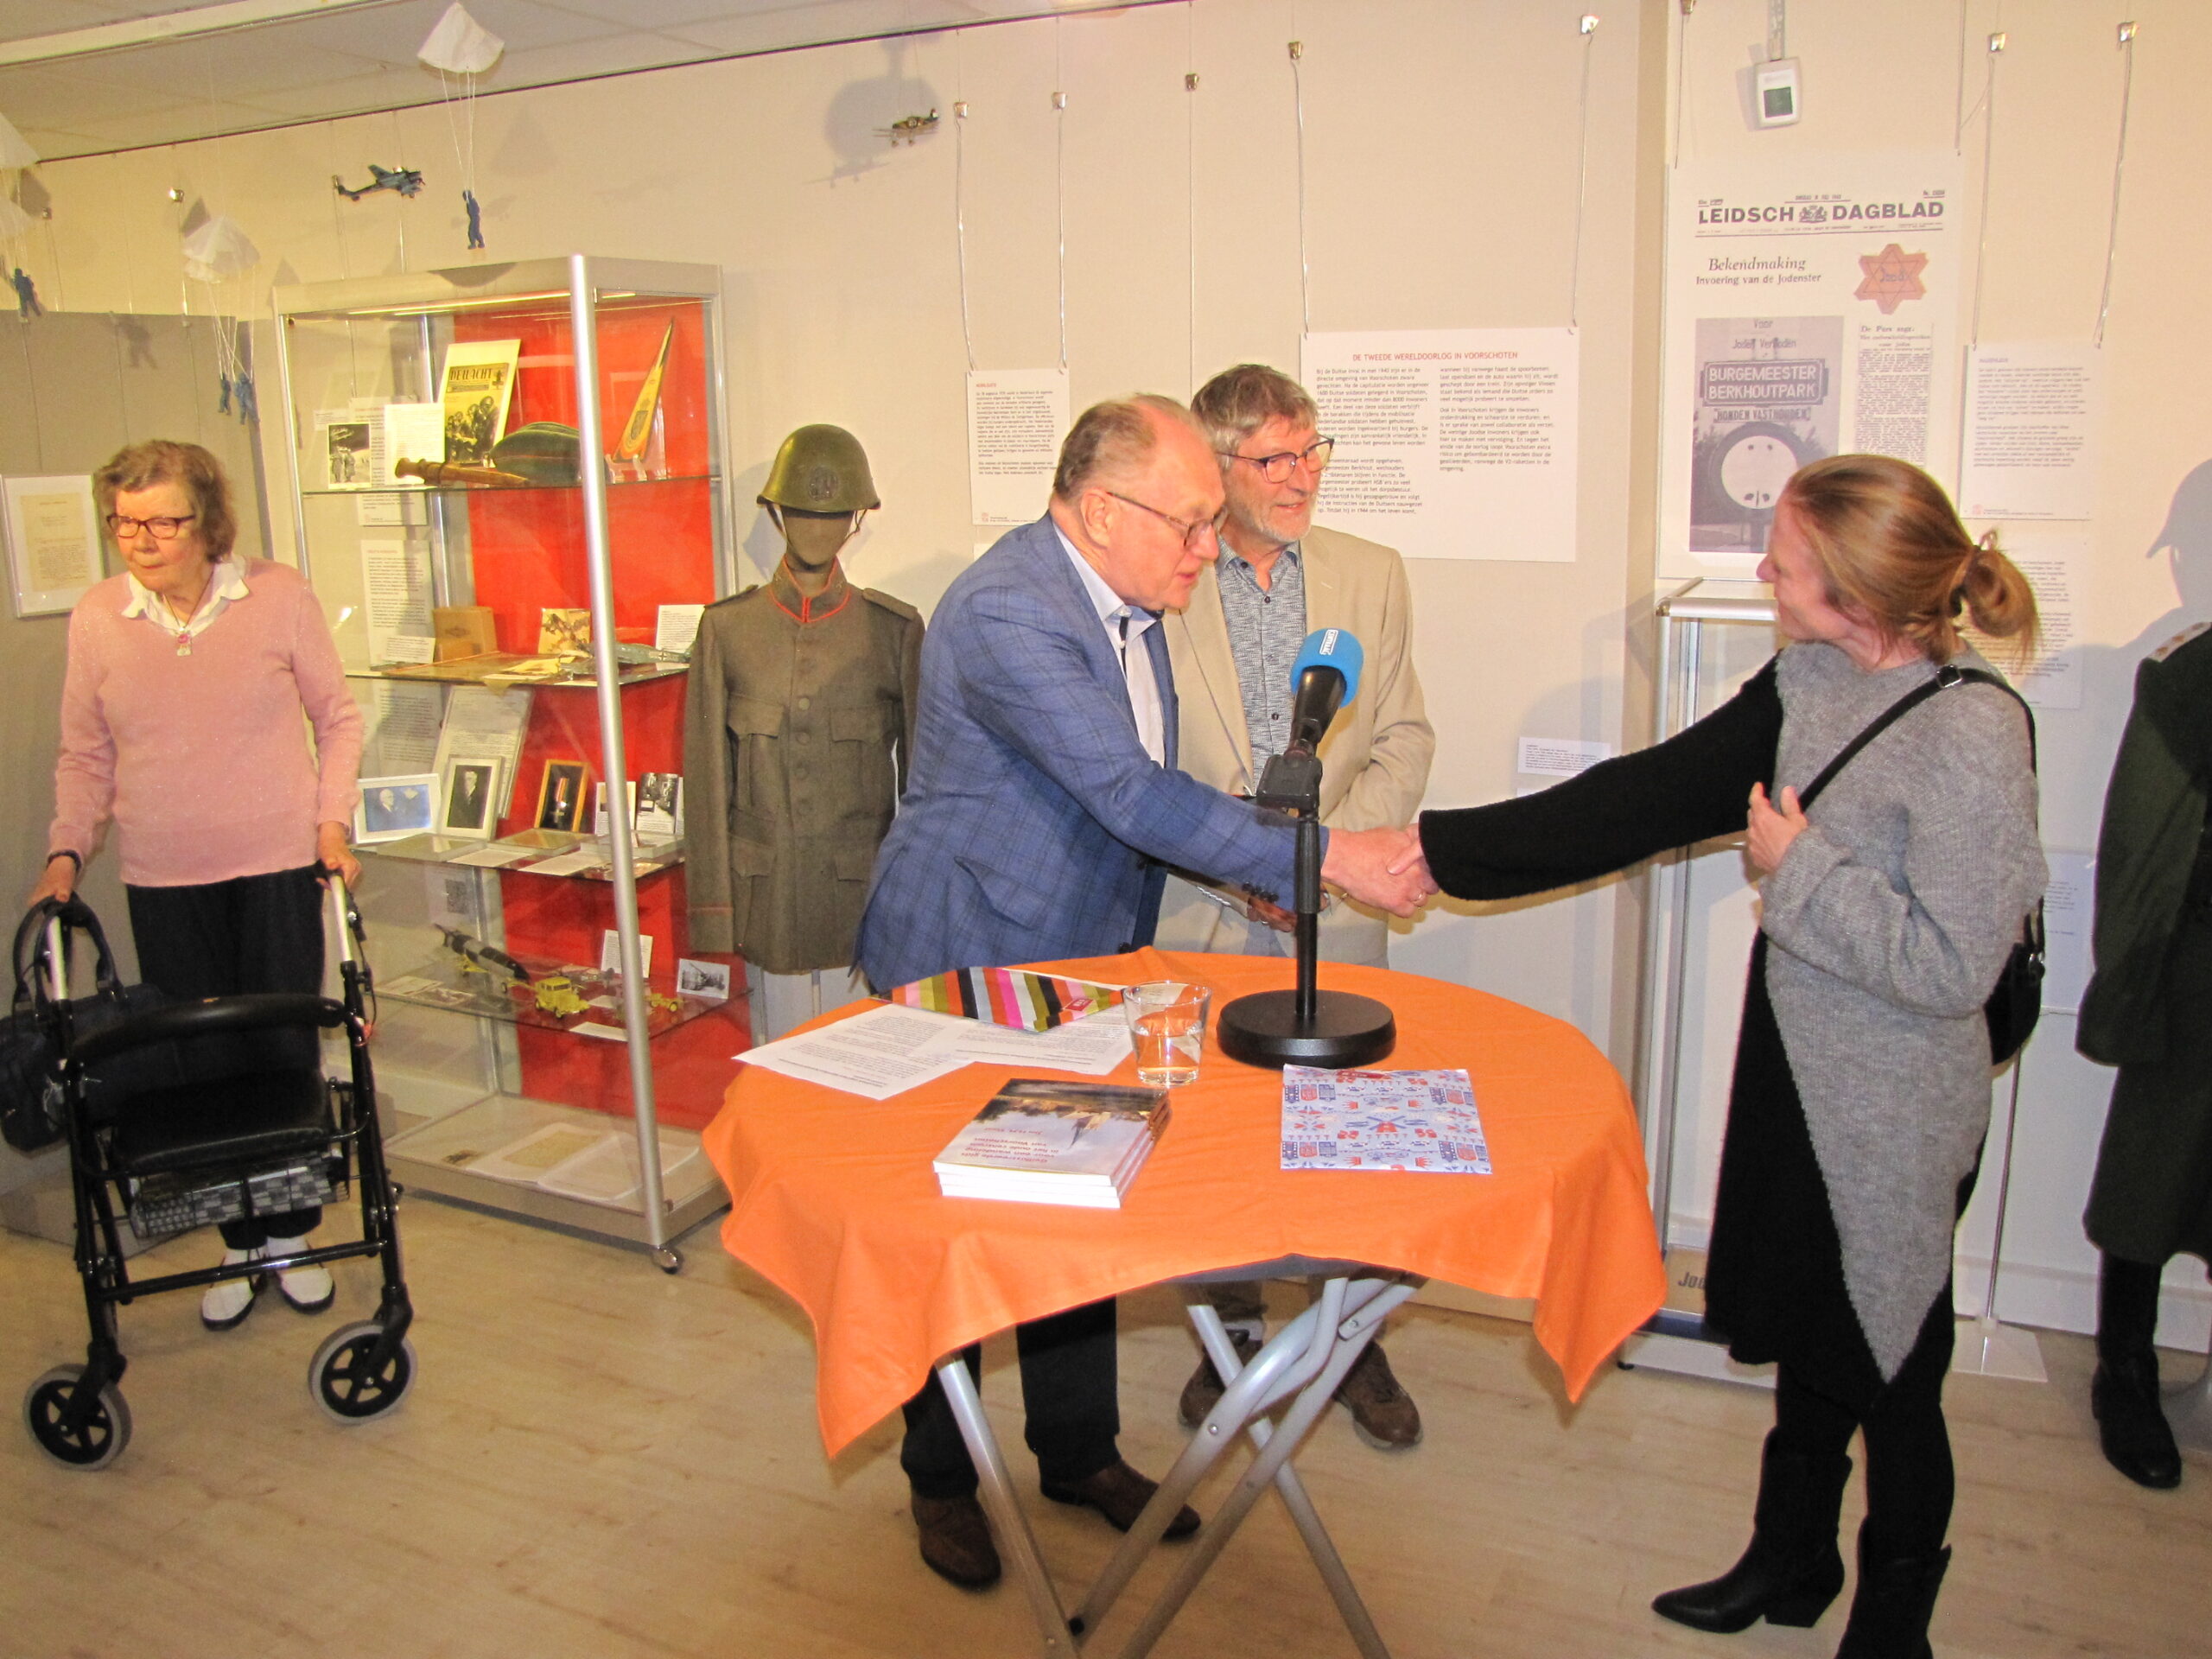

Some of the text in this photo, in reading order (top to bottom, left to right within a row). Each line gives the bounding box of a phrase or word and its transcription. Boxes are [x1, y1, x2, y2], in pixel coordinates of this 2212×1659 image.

[1699, 201, 1944, 224] LEIDSCH DAGBLAD
[1708, 256, 1807, 271] Bekendmaking
[1696, 276, 1738, 286] Invoering
[1763, 275, 1773, 283] de
[1777, 274, 1821, 285] Jodenster
[1754, 319, 1774, 329] Voor
[1363, 353, 1392, 361] TWEEDE
[1394, 352, 1452, 360] WERELDOORLOG
[1454, 352, 1462, 360] IN
[1464, 351, 1518, 360] VOORSCHOTEN
[1708, 365, 1817, 382] BURGEMEESTER
[1708, 384, 1815, 399] BERKHOUTPARK
[1717, 408, 1807, 422] HONDEN VASTHOUDEN
